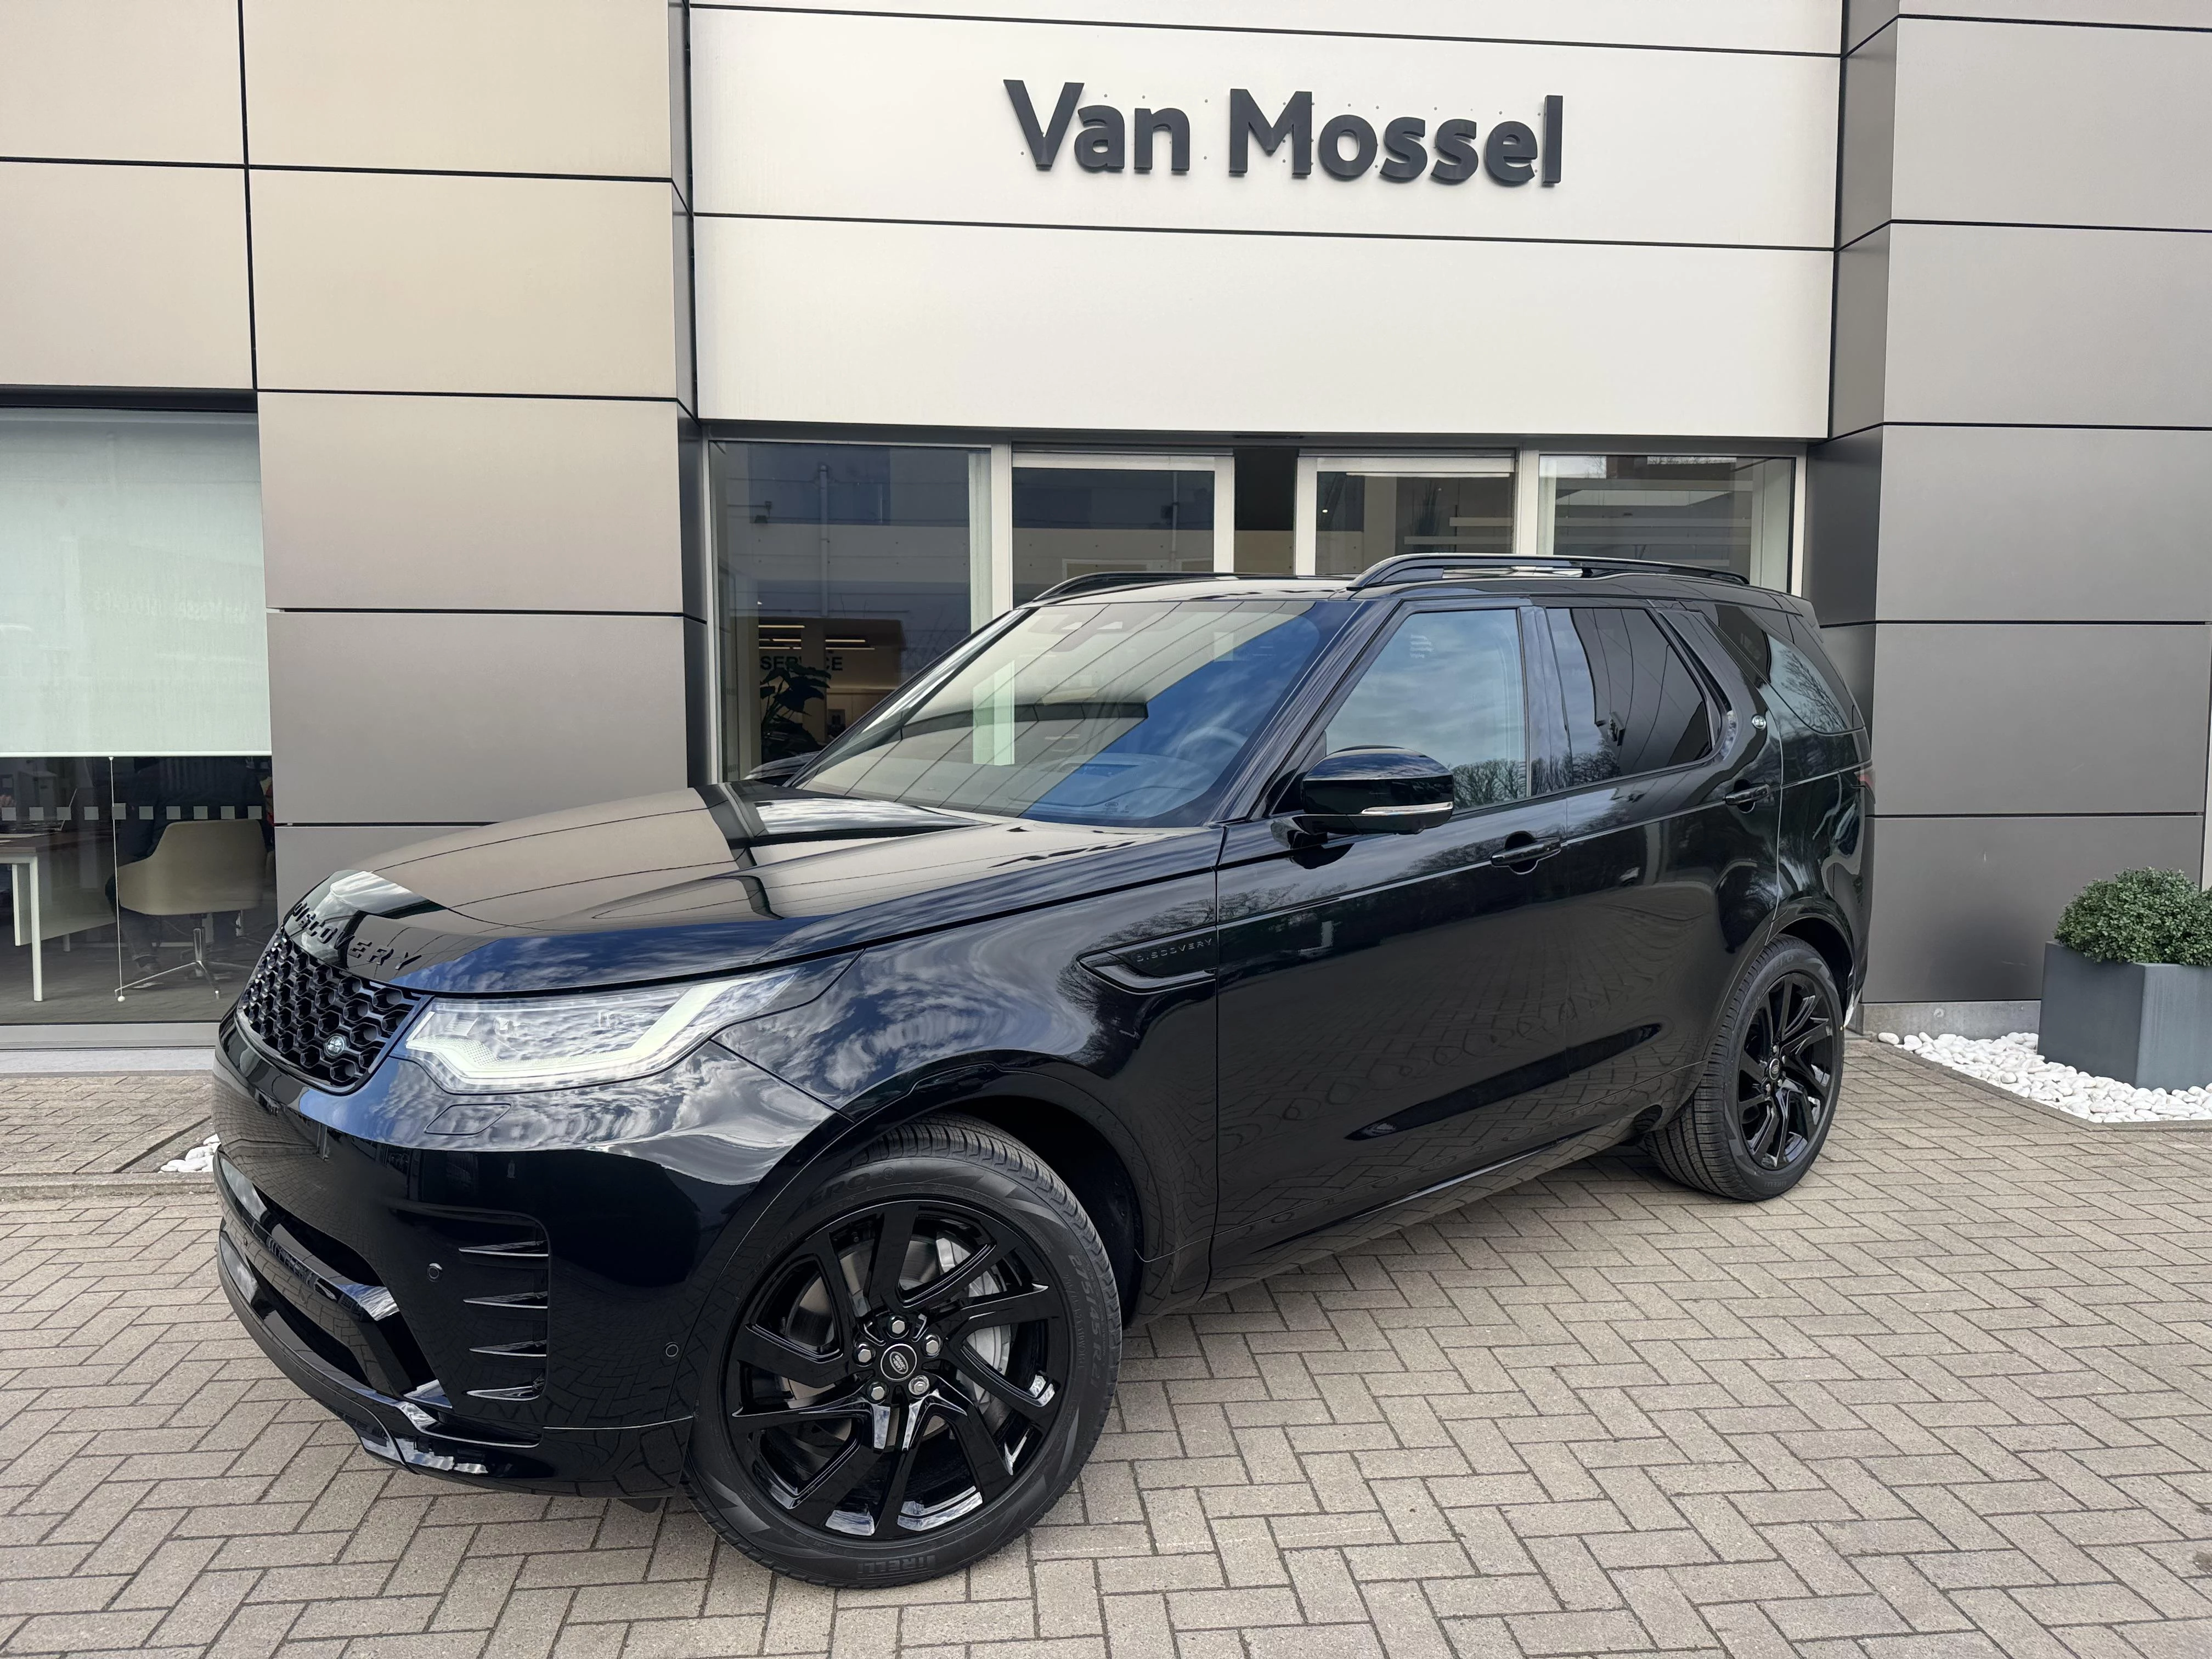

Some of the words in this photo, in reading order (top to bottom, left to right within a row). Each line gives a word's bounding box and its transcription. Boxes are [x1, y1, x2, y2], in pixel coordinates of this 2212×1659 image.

[1003, 79, 1190, 173] Van
[1229, 88, 1564, 187] Mossel
[760, 655, 843, 671] SERE
[293, 900, 422, 970] DISCOVERY
[1068, 1255, 1101, 1335] 275/45
